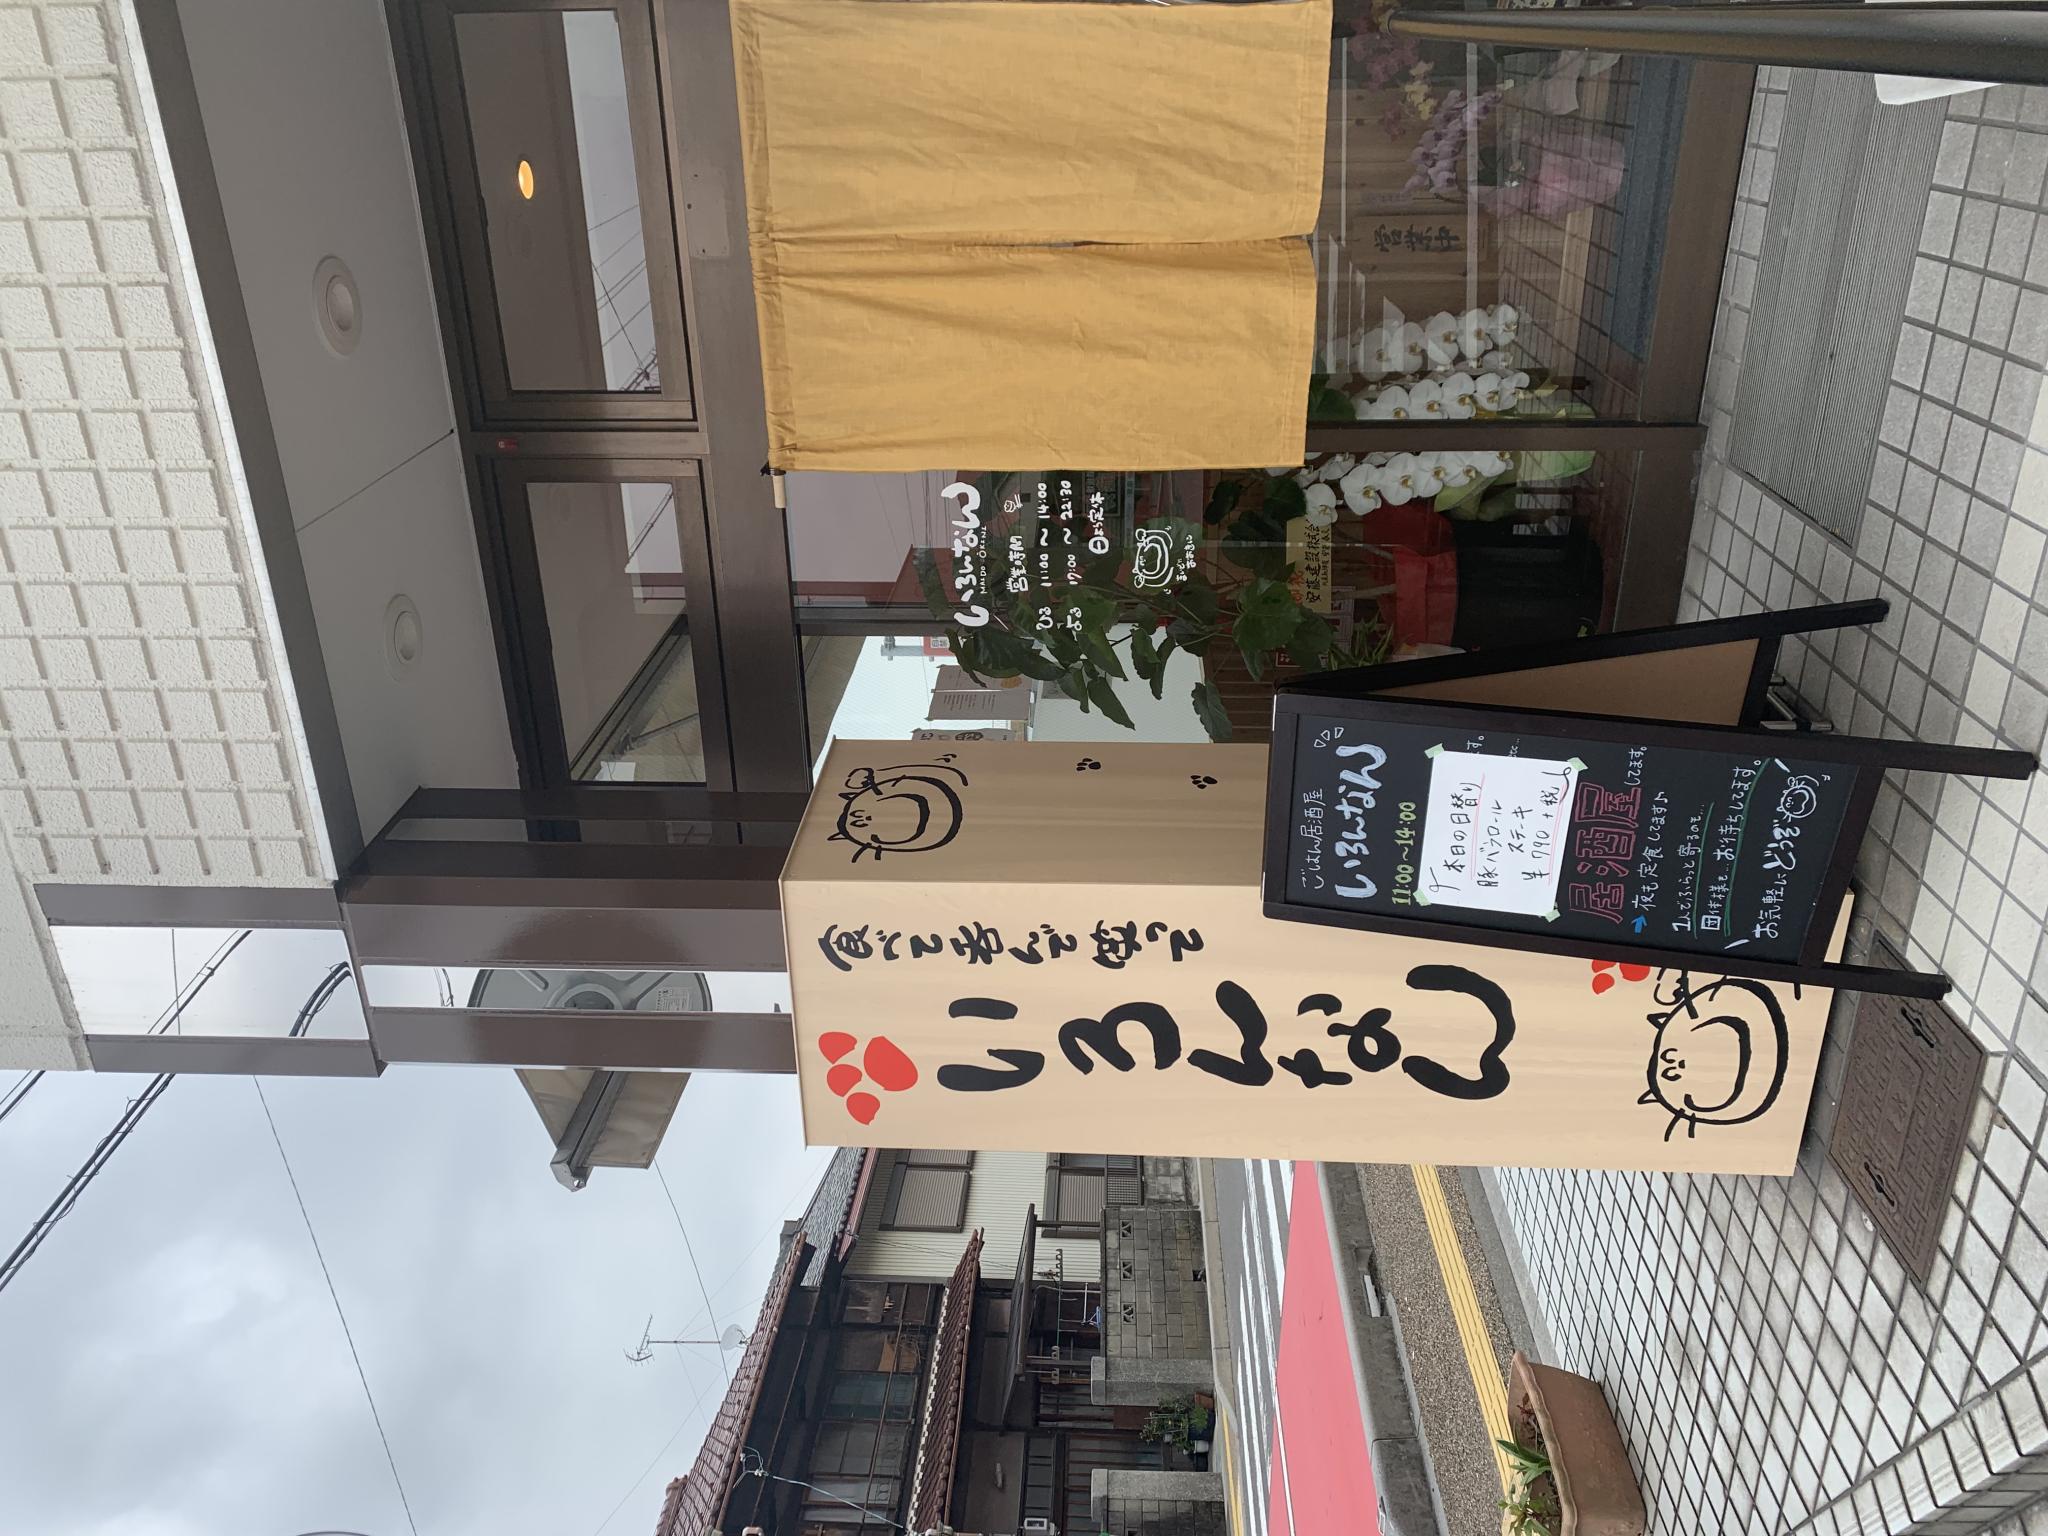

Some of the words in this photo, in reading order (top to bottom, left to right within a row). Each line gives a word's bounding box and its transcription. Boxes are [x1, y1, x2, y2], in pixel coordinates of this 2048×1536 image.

[1373, 223, 1461, 253] 営業中
[1037, 482, 1050, 519] 14:00
[1059, 480, 1073, 521] 22:30
[1087, 491, 1110, 555] 日よう定休
[940, 481, 990, 627] いろんなん
[1005, 535, 1029, 593] 営業時間
[1039, 553, 1052, 587] 11:00
[1066, 553, 1083, 586] 17:00
[1183, 534, 1197, 570] おおきに
[1304, 518, 1322, 604] 安藤建設株式会
[1035, 606, 1054, 631] ひる
[1065, 606, 1083, 632] よる
[1465, 735, 1485, 754] す。
[1300, 787, 1327, 890] ごはん居酒屋
[1334, 743, 1388, 899] いろんなん
[1442, 781, 1482, 873] 本日の日替り
[1476, 799, 1503, 888] 豚バラロール
[1507, 805, 1533, 854] ステーキ
[936, 964, 1516, 1101] いろんなん
